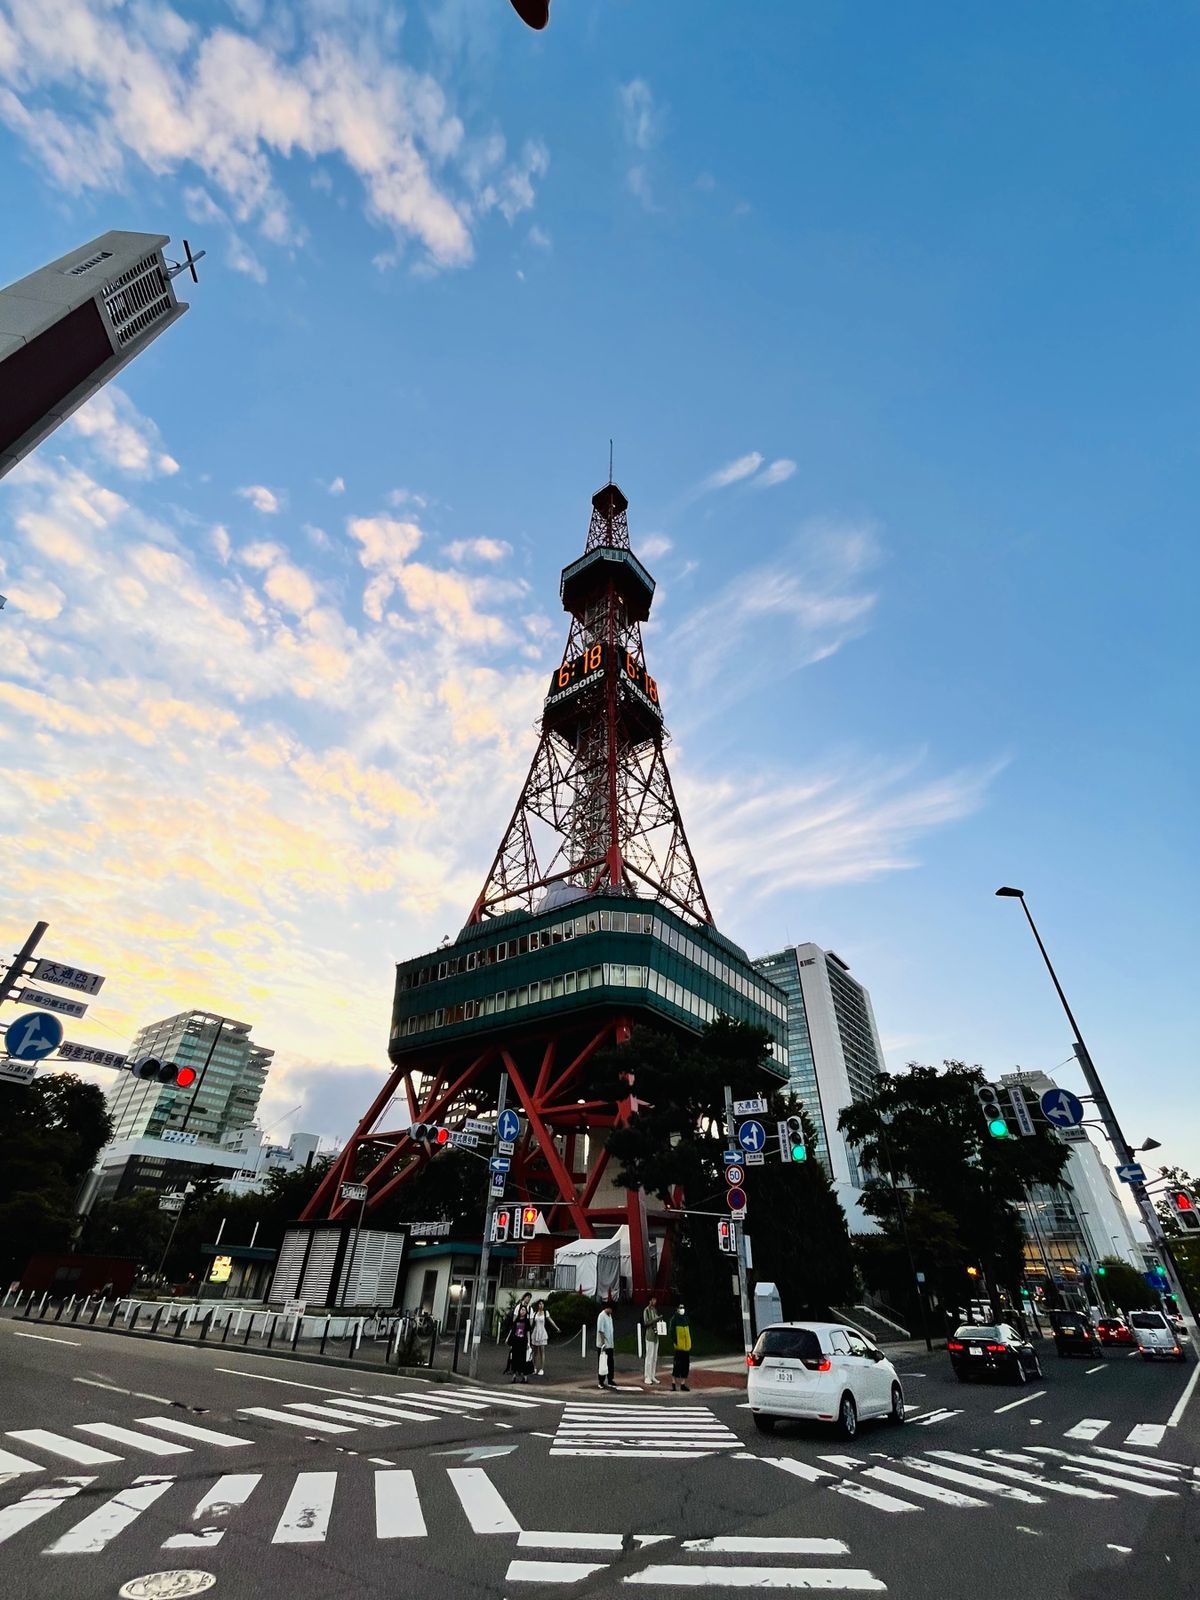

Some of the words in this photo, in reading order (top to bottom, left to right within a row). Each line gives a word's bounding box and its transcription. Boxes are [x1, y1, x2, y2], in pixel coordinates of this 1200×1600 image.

[543, 669, 605, 708] Panasonic
[619, 668, 664, 721] Panasonic
[60, 1043, 125, 1070] 時差式信号機
[729, 1170, 740, 1180] 50
